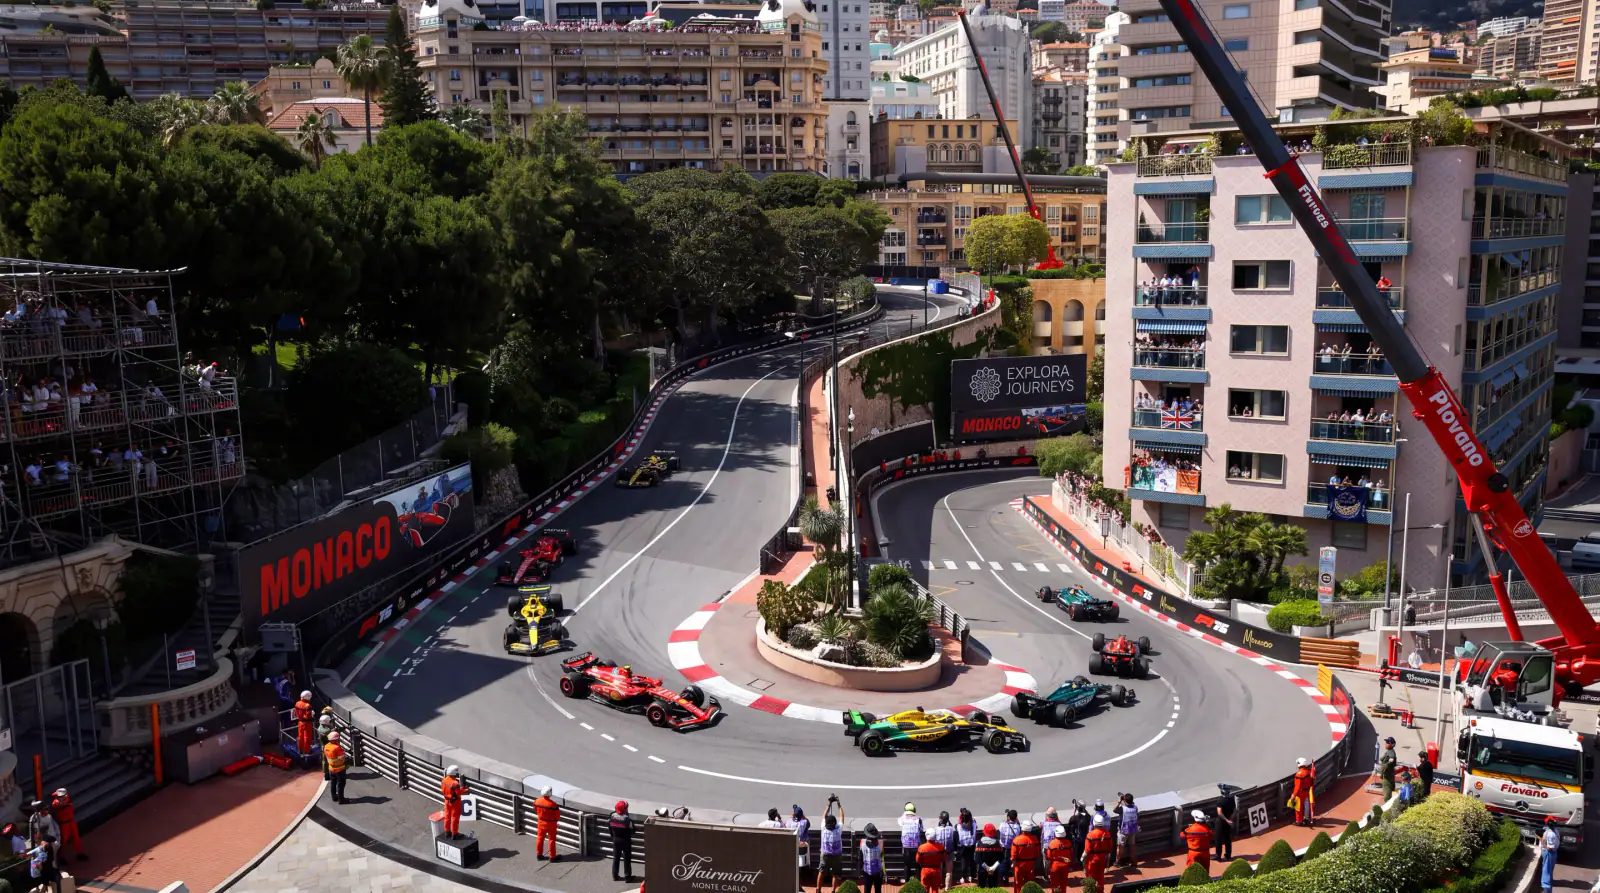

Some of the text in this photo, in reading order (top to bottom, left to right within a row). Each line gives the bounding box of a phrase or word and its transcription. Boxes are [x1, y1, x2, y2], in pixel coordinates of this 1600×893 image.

[1007, 364, 1070, 380] EXPLORA
[1006, 380, 1075, 396] JOURNEYS
[962, 415, 1021, 434] MONACO
[261, 515, 391, 617] MONACO
[1250, 807, 1267, 828] 5C
[671, 852, 765, 885] Fairmont
[691, 881, 748, 893] MONTE CARLO
